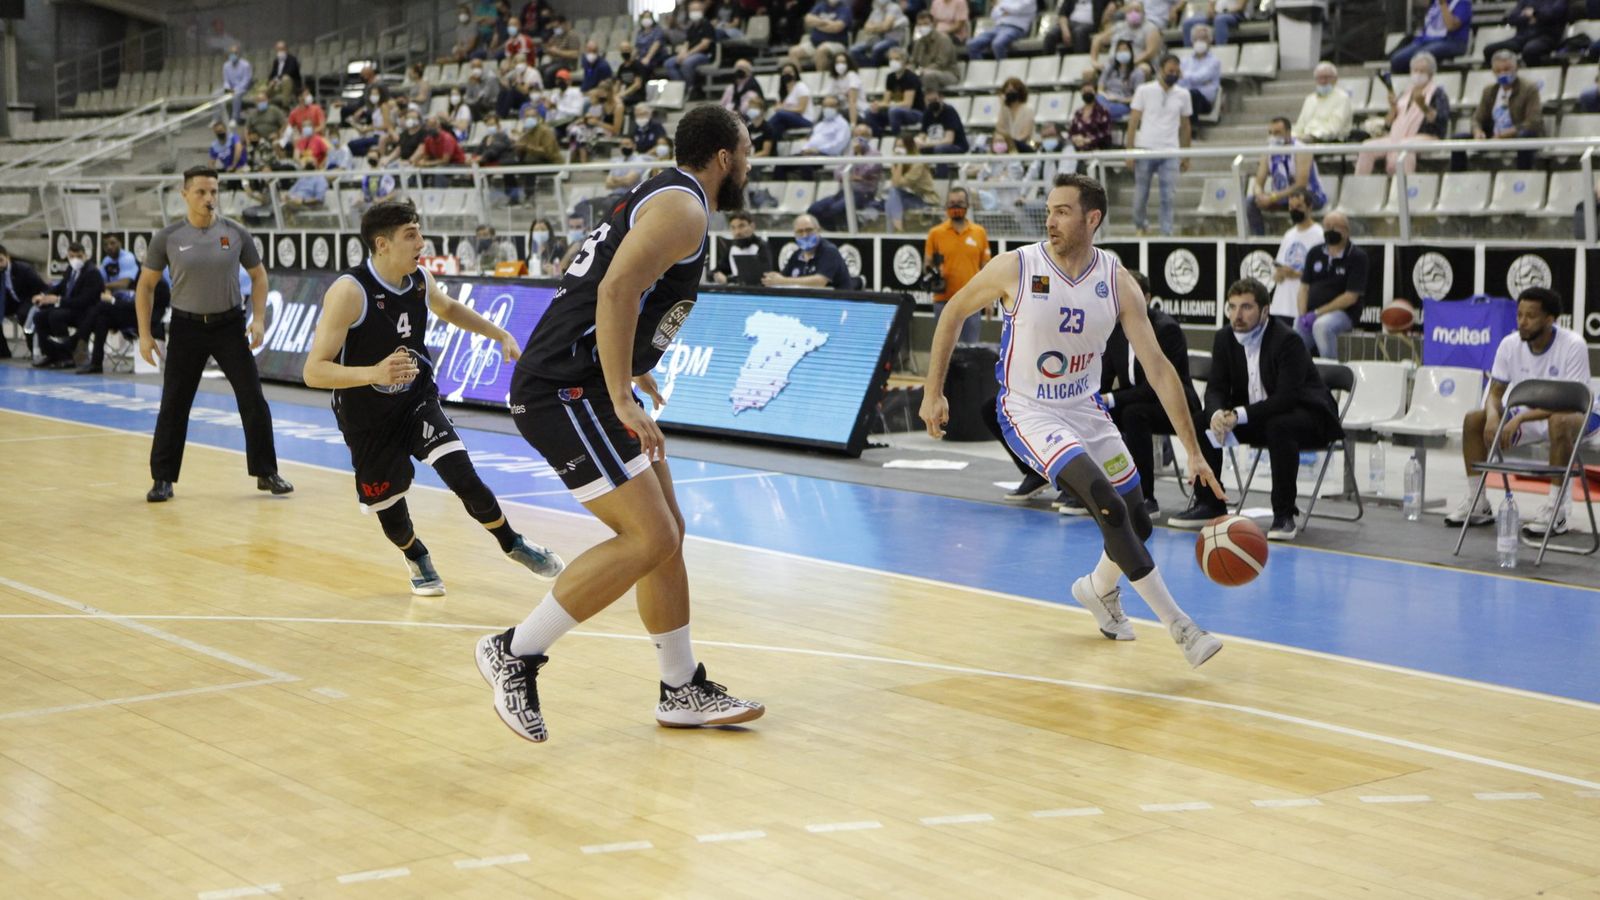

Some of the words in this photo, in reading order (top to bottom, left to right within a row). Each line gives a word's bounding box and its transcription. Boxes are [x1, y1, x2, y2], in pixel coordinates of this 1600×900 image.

[1059, 307, 1085, 334] 23
[1181, 300, 1216, 316] ALICANTE
[396, 312, 412, 338] 4
[1432, 326, 1491, 346] molten
[1037, 374, 1089, 400] ALICANTE
